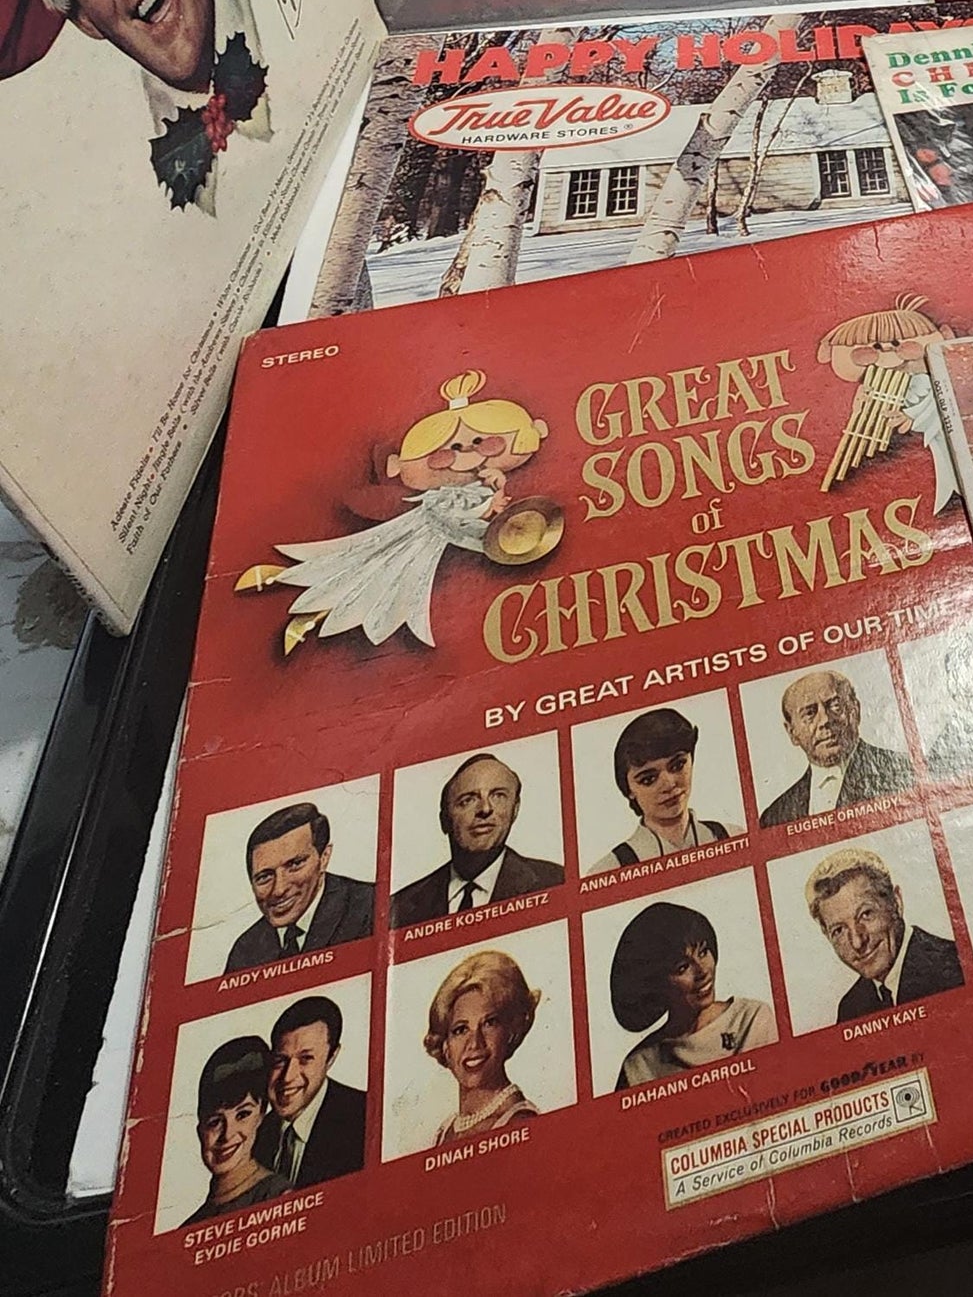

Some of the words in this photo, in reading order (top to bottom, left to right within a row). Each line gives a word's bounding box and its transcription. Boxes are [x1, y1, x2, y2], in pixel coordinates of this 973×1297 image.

[411, 34, 661, 86] HAPPY
[428, 96, 531, 135] True
[515, 93, 660, 130] Value
[897, 88, 930, 104] Is
[461, 129, 551, 144] HARDWARE
[556, 125, 619, 140] STORES
[260, 343, 341, 369] STEREO
[575, 348, 797, 448] GREAT
[110, 490, 133, 531] Adeste
[129, 452, 151, 491] Fidelis
[159, 412, 170, 426] Be
[167, 380, 185, 411] Home
[118, 509, 138, 544] Silent
[135, 478, 153, 510] Night
[152, 440, 170, 473] Jingle
[166, 414, 182, 440] Bells
[579, 408, 817, 522] SONGS
[126, 526, 145, 555] Faith
[143, 510, 152, 522] of
[150, 483, 162, 506] Our
[160, 440, 182, 481] Fathers
[690, 497, 724, 537] of
[482, 494, 937, 666] CHRISTMAS
[484, 701, 531, 730] BY
[534, 673, 638, 714] GREAT
[641, 641, 770, 693] ARTISTS
[776, 627, 817, 657] OF
[822, 614, 883, 646] OUR
[786, 812, 835, 836] EUGENE
[835, 798, 900, 824] ORMANDY
[578, 872, 618, 892] ANNA
[618, 862, 664, 883] MARIA
[663, 837, 751, 873] ALBERGHETTI
[403, 916, 453, 941] ANDRE
[454, 893, 550, 929] KOSTELANETZ
[217, 967, 261, 993] ANDY
[261, 950, 335, 981] WILLIAMS
[843, 1016, 891, 1041] DANNY
[890, 1005, 928, 1030] KAYE
[621, 1075, 690, 1110] DIAHANN
[690, 1059, 757, 1090] CARROLL
[658, 1117, 712, 1144] CREATED
[714, 1093, 791, 1125] EXCLUSIVELY
[793, 1086, 817, 1103] FOR
[820, 1055, 909, 1095] GOODYEAR
[911, 1051, 926, 1064] BY
[423, 1144, 475, 1172] DINAH
[476, 1126, 531, 1155] SHORE
[670, 1136, 749, 1175] COLUMBIA
[752, 1121, 812, 1149] SPECIAL
[814, 1091, 891, 1129] PRODUCTS
[675, 1181, 686, 1197] A
[692, 1164, 745, 1191] Service
[749, 1156, 764, 1172] of
[768, 1135, 833, 1165] Columbia
[838, 1114, 893, 1142] Records
[183, 1221, 236, 1249] STEVE
[236, 1191, 325, 1229] LAWRENCE
[193, 1239, 243, 1266] EYDIE
[245, 1216, 308, 1248] GORME
[268, 1255, 341, 1297] ALBUM
[347, 1228, 427, 1273] LIMITED
[430, 1203, 507, 1244] EDITION
